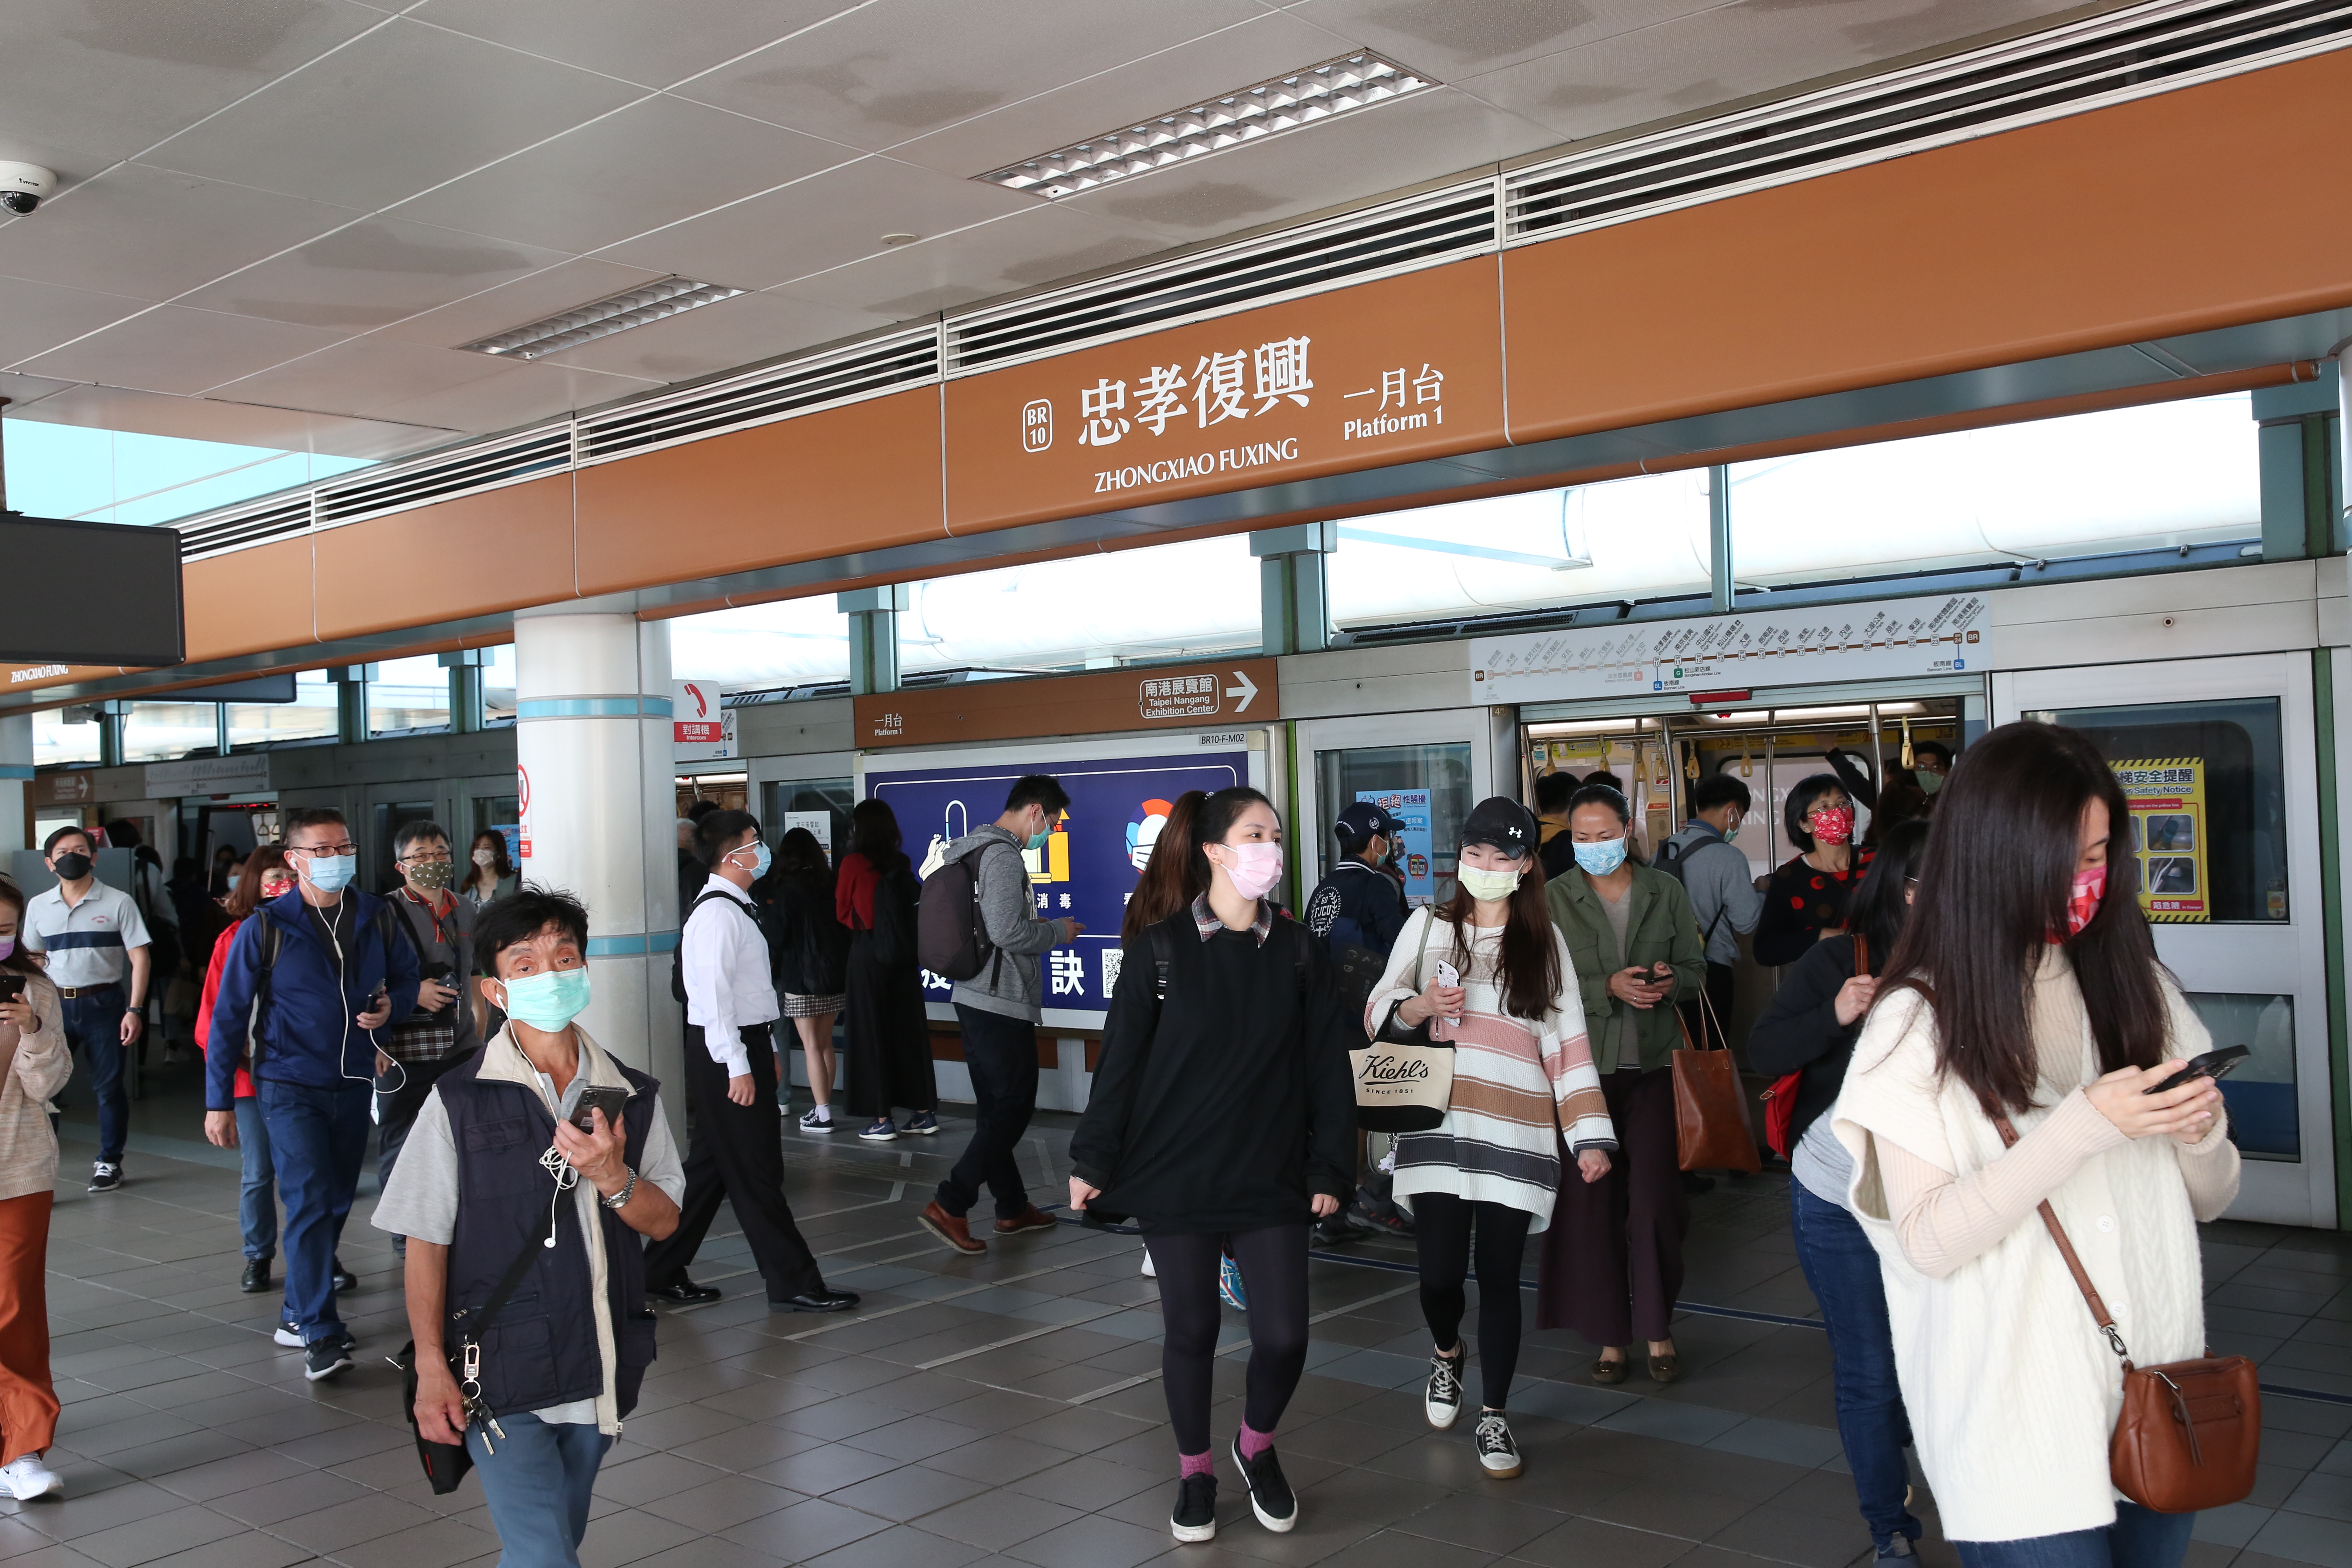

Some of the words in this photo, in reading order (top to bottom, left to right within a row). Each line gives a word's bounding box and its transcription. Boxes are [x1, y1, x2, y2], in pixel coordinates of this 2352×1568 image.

[1078, 335, 1314, 447] 忠孝復興
[1343, 363, 1444, 412] 一月台
[1027, 407, 1047, 426] BR
[1344, 412, 1428, 441] Platform
[1433, 405, 1442, 424] 1
[1029, 427, 1046, 445] 10
[1094, 452, 1215, 493] ZHONGXIAO
[1220, 437, 1298, 471] FUXING
[11, 666, 46, 683] ZHONGXIAO
[1145, 677, 1213, 697] 南港展覽館
[1149, 697, 1172, 707] Taipei
[1174, 695, 1210, 705] Nangang
[1146, 706, 1185, 717] Exhibition
[1187, 705, 1214, 714] Center
[874, 713, 902, 727] 一月台
[682, 724, 710, 735] 對講機
[875, 728, 898, 736] Platform
[1201, 733, 1245, 744] BR10-F-M02
[2134, 786, 2162, 795] Safety
[2163, 786, 2192, 794] Notice
[1377, 794, 1401, 810] 拒絕
[1403, 794, 1426, 804] 性騷擾
[1037, 893, 1071, 909] 消毒
[1321, 896, 1329, 904] 60
[1314, 904, 1332, 918] FJCU
[1050, 949, 1085, 996] 訣
[1359, 1055, 1429, 1080] Kiehl's
